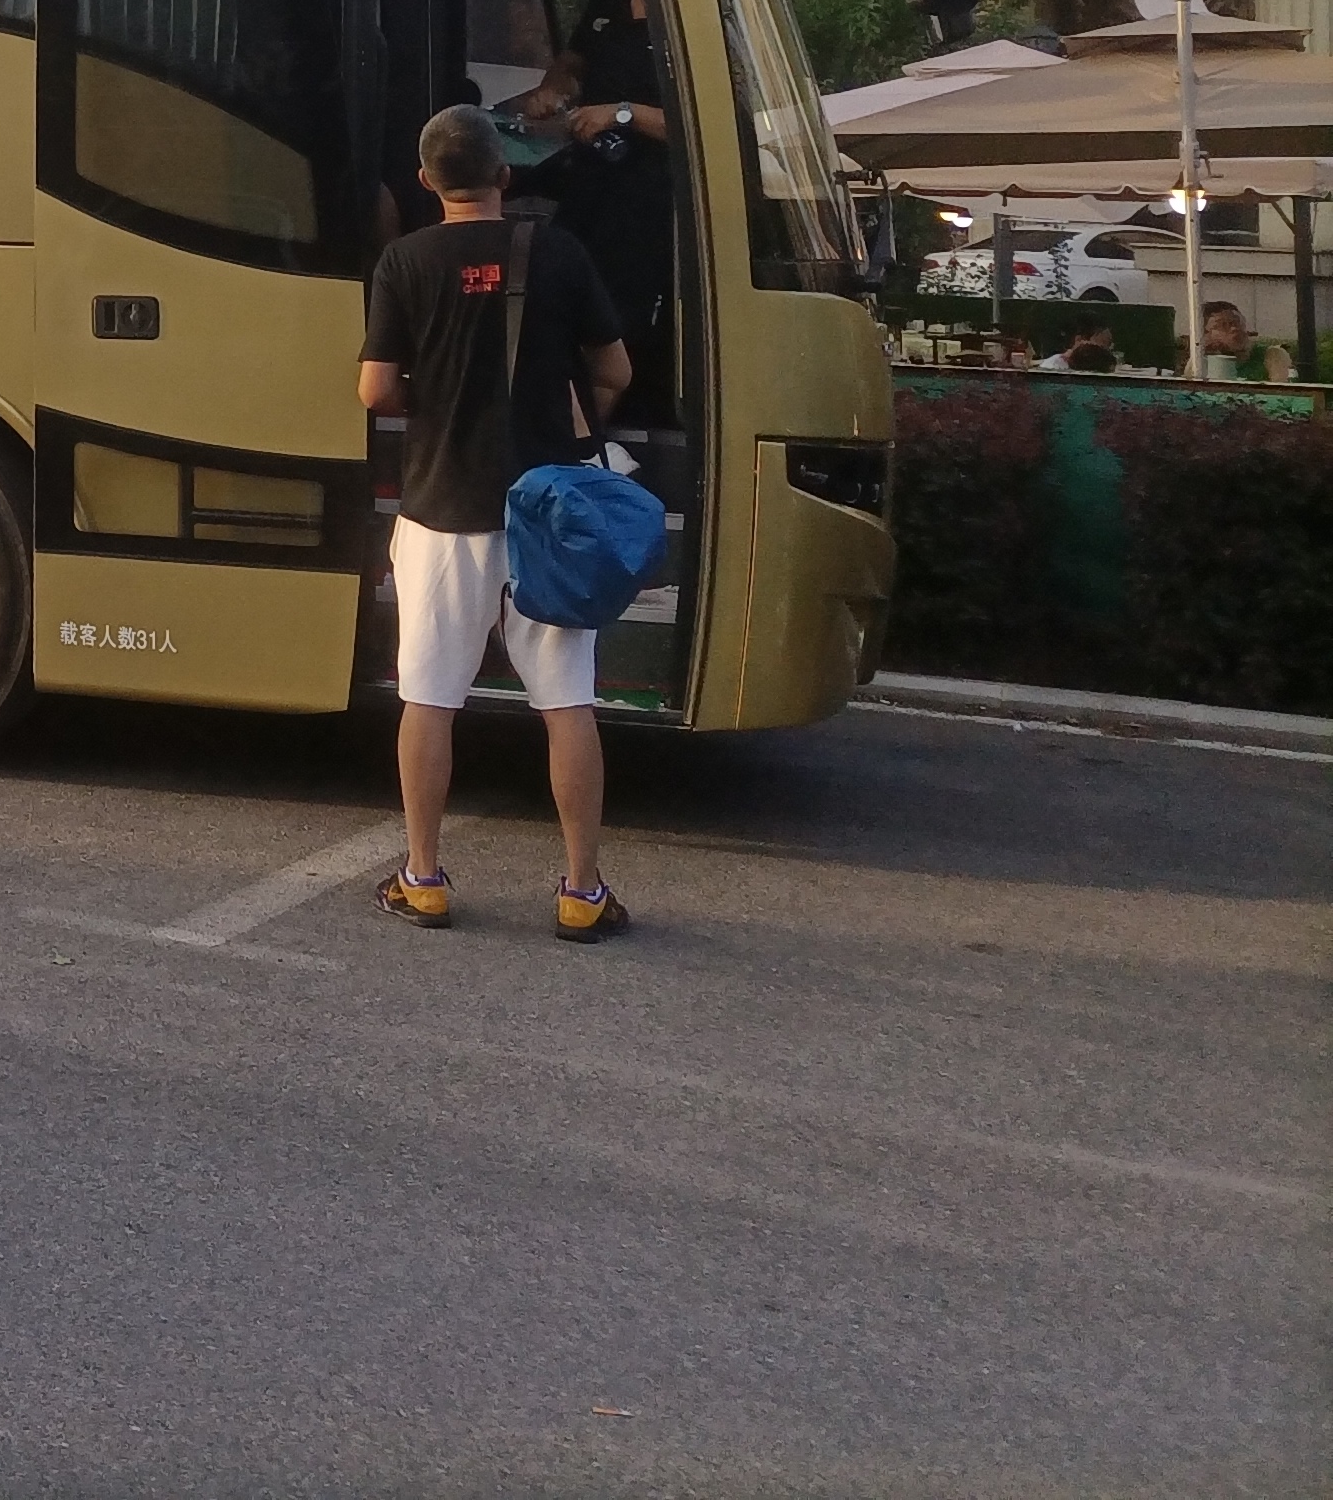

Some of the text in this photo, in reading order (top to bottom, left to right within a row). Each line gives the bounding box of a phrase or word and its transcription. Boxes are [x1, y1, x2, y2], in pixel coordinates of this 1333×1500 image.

[461, 264, 501, 284] 中国
[59, 620, 179, 654] 载客人数31人
